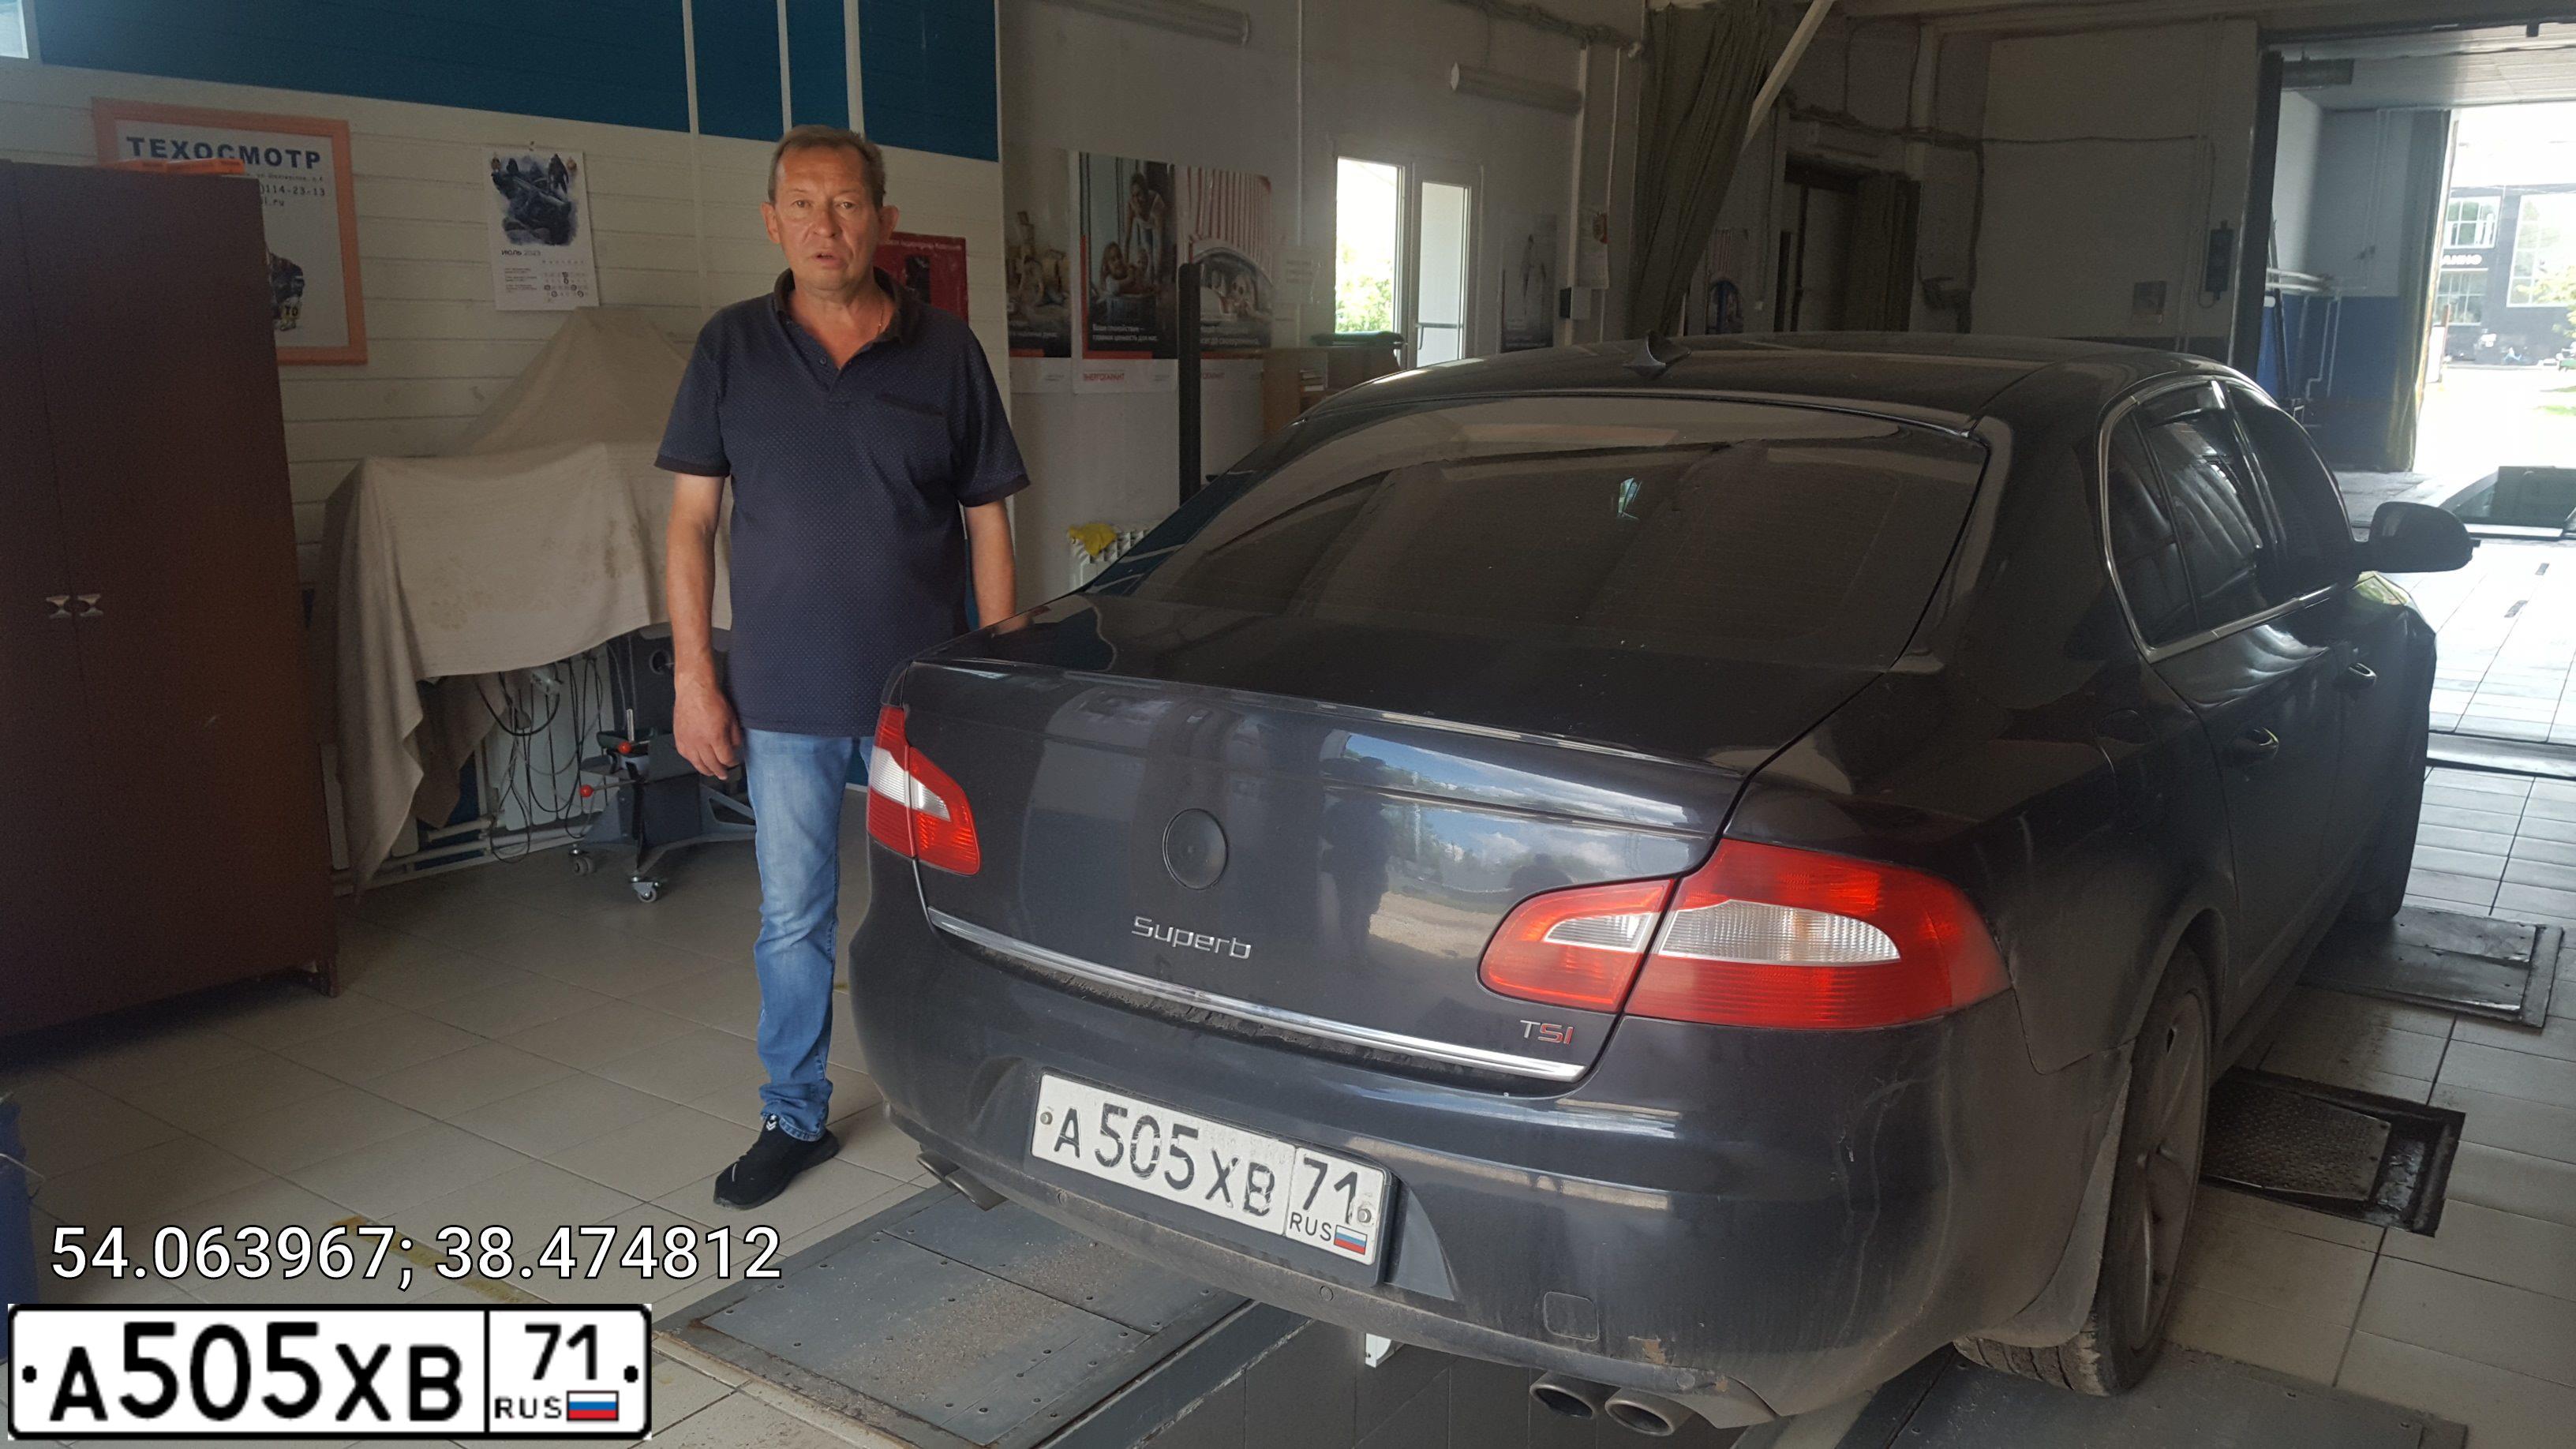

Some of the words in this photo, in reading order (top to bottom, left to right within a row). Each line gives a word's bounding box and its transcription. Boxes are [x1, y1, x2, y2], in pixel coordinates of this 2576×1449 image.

[126, 137, 320, 169] ТЕХОСМОТР
[1132, 915, 1251, 960] Superb
[1520, 1020, 1574, 1045] TSI
[1303, 1156, 1358, 1225] 71
[1290, 1211, 1332, 1241] RUS
